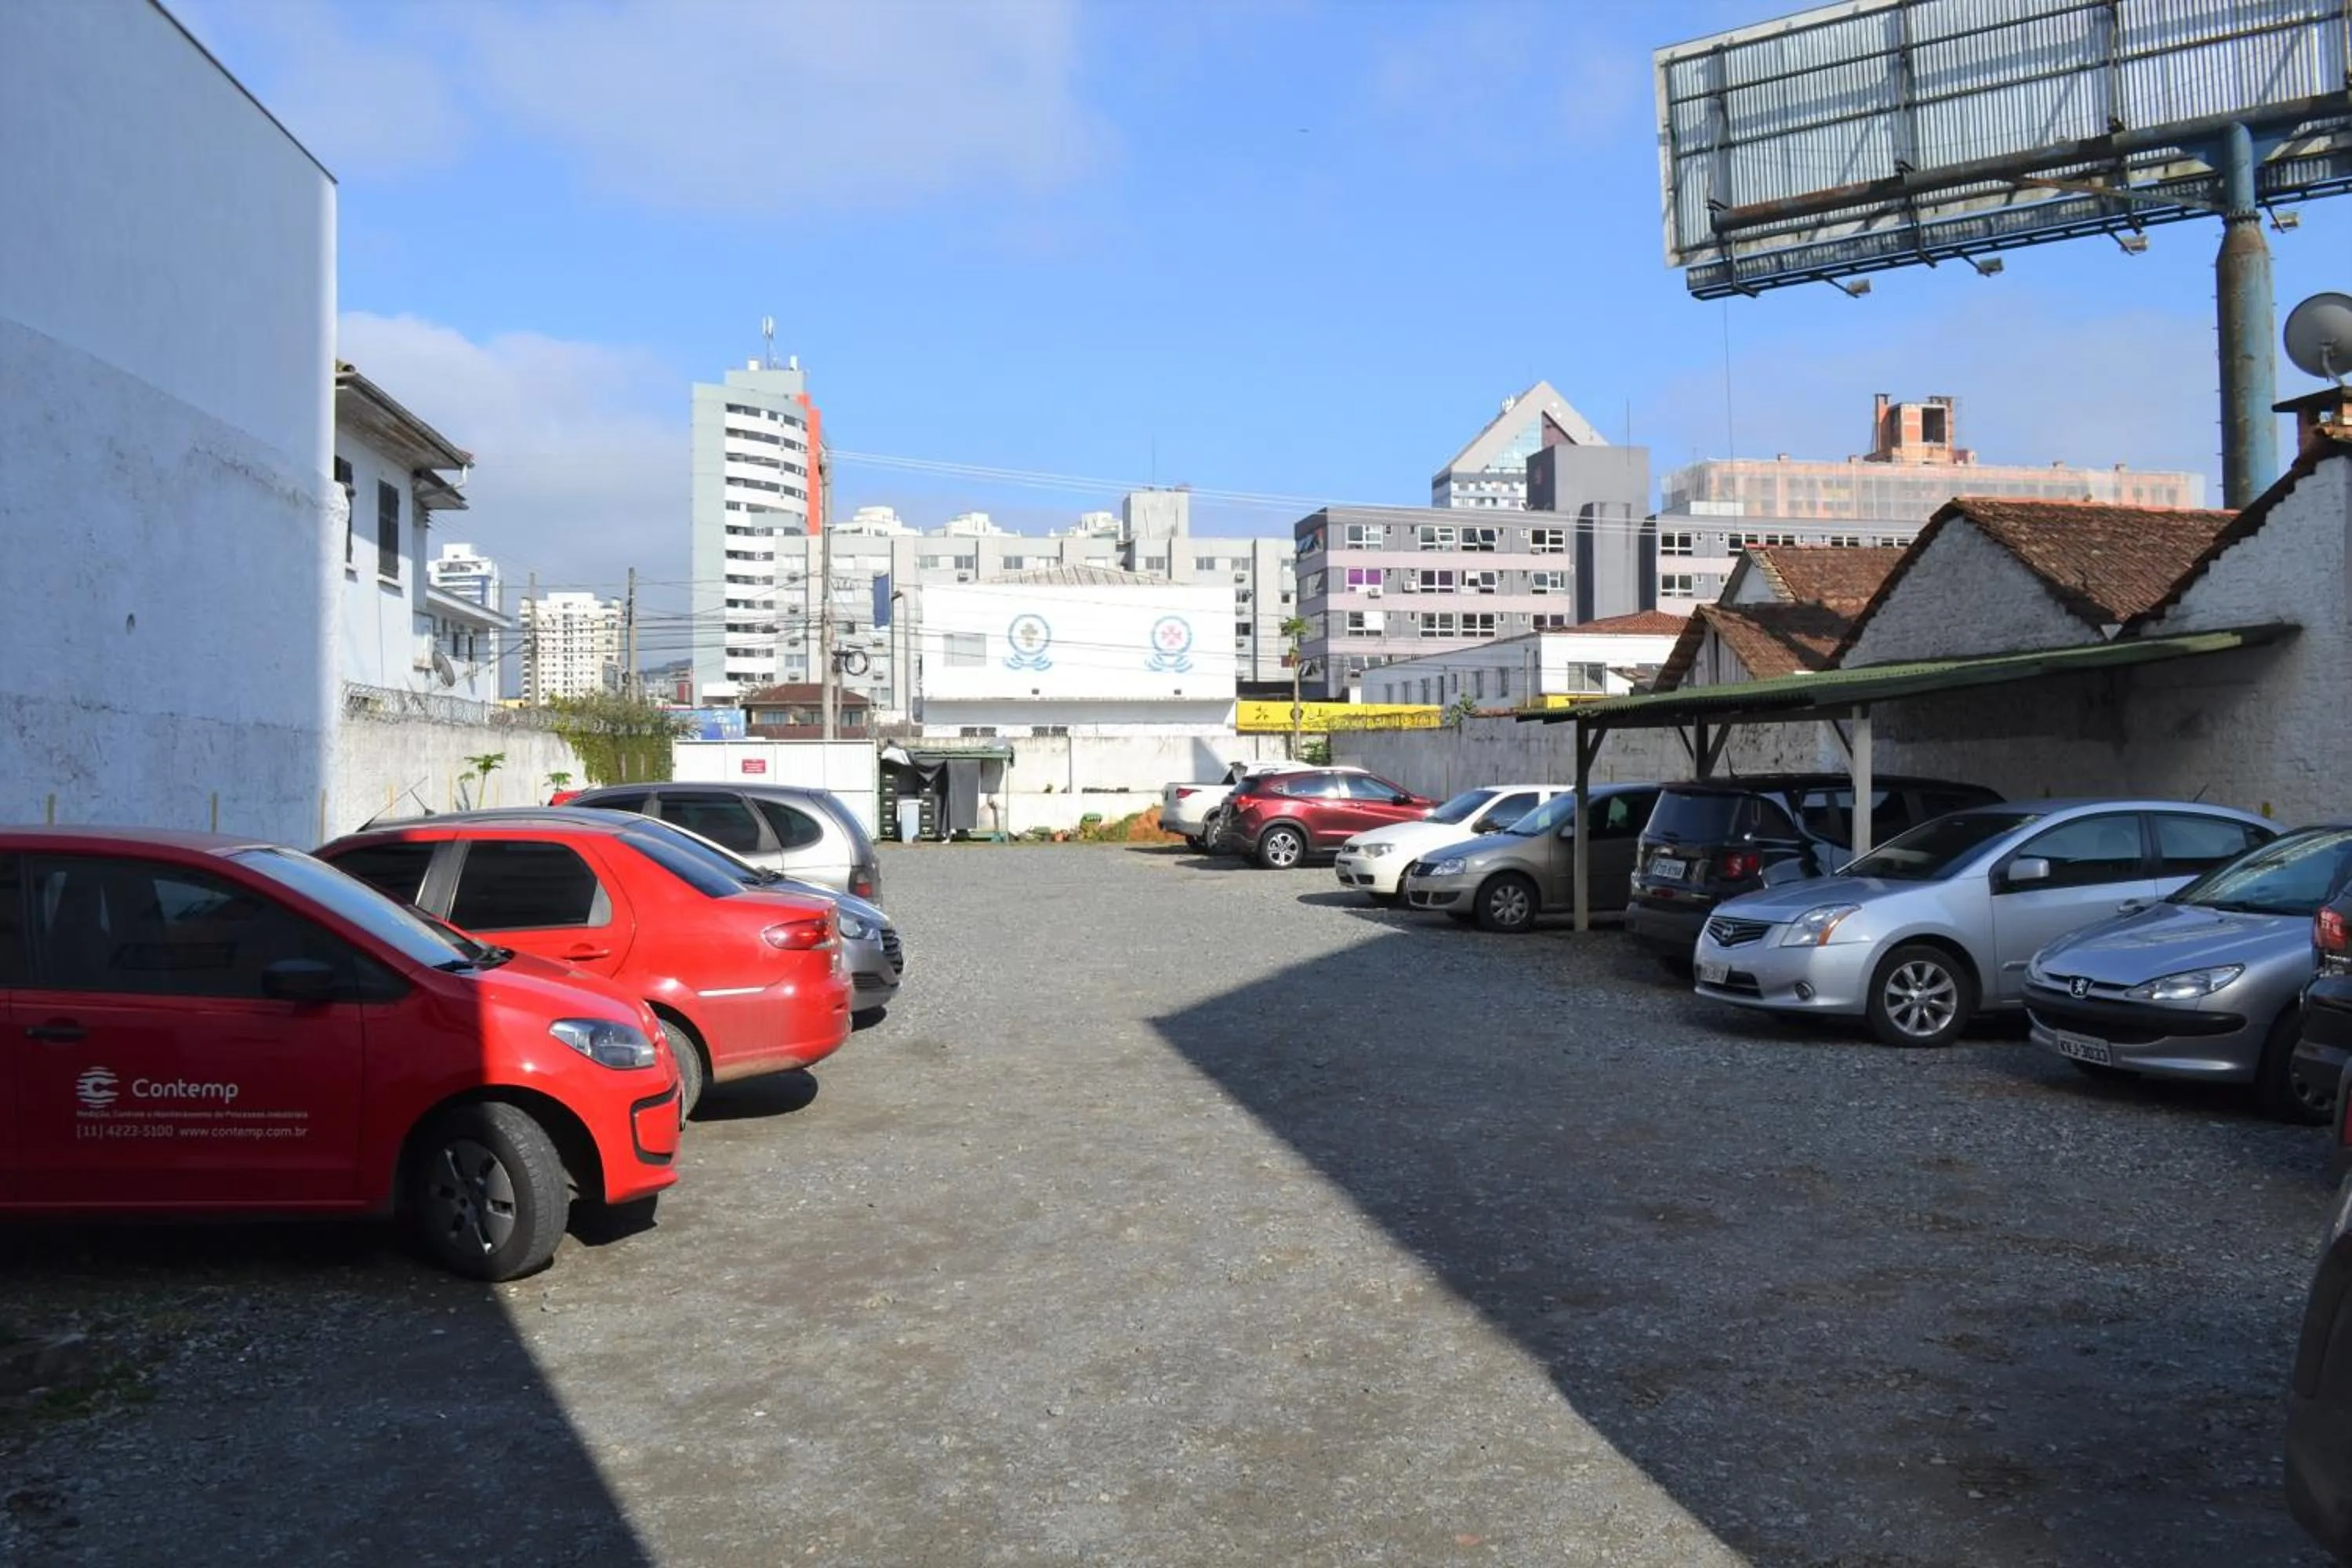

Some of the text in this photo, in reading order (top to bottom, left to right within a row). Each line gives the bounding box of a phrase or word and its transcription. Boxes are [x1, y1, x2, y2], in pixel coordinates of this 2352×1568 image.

[132, 1079, 238, 1104] Contemp
[107, 1124, 173, 1138] 4223-5100
[180, 1125, 307, 1139] www.contemp.com.br
